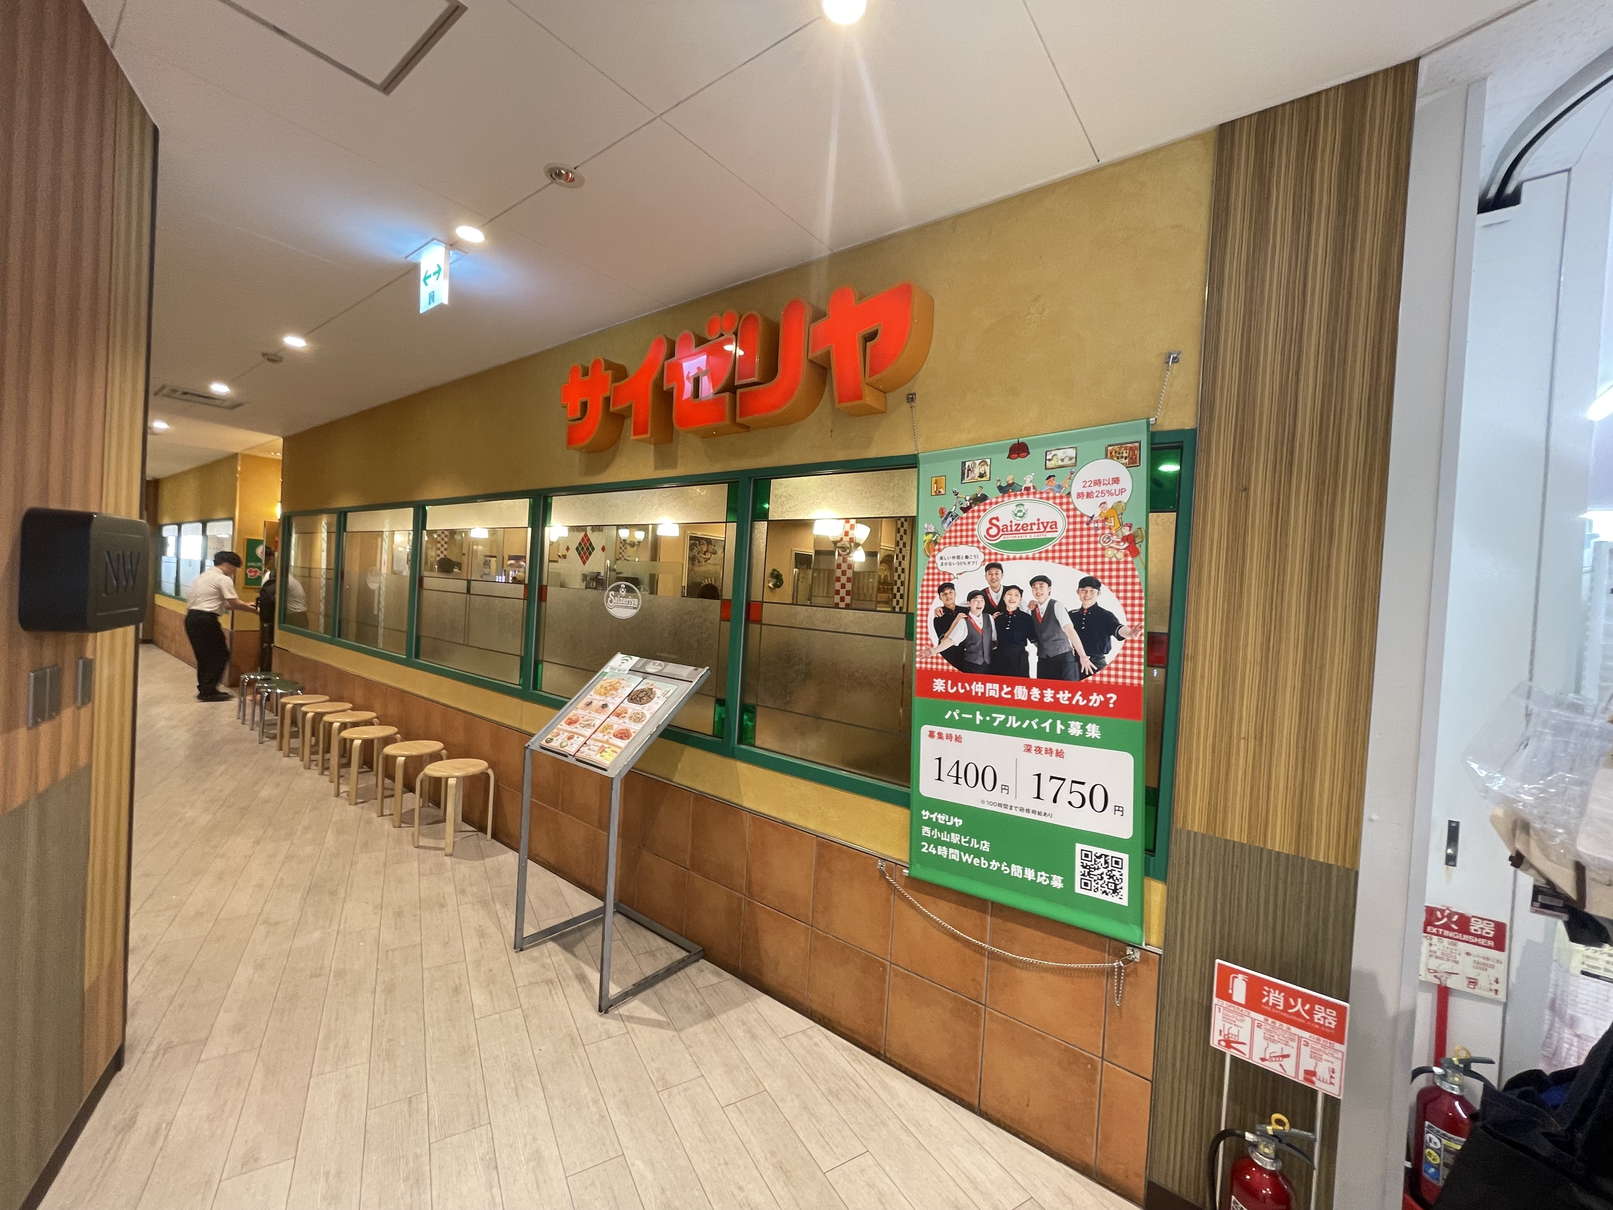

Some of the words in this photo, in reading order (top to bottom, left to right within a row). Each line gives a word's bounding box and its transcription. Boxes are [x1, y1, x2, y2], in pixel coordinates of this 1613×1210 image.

[561, 282, 915, 449] サイゼリヤ
[1082, 476, 1121, 488] 22時以降
[985, 516, 1058, 539] Saizeriya
[932, 678, 1118, 708] 楽しい仲間と働きませんか?
[944, 709, 1102, 739] パート・アルバイト募集
[927, 730, 964, 744] 募集時給
[1023, 743, 1065, 759] 深夜時給
[920, 809, 963, 828] サイゼリヤ
[921, 825, 991, 852] 西小山駅ビル店
[1261, 986, 1337, 1029] 消火器
